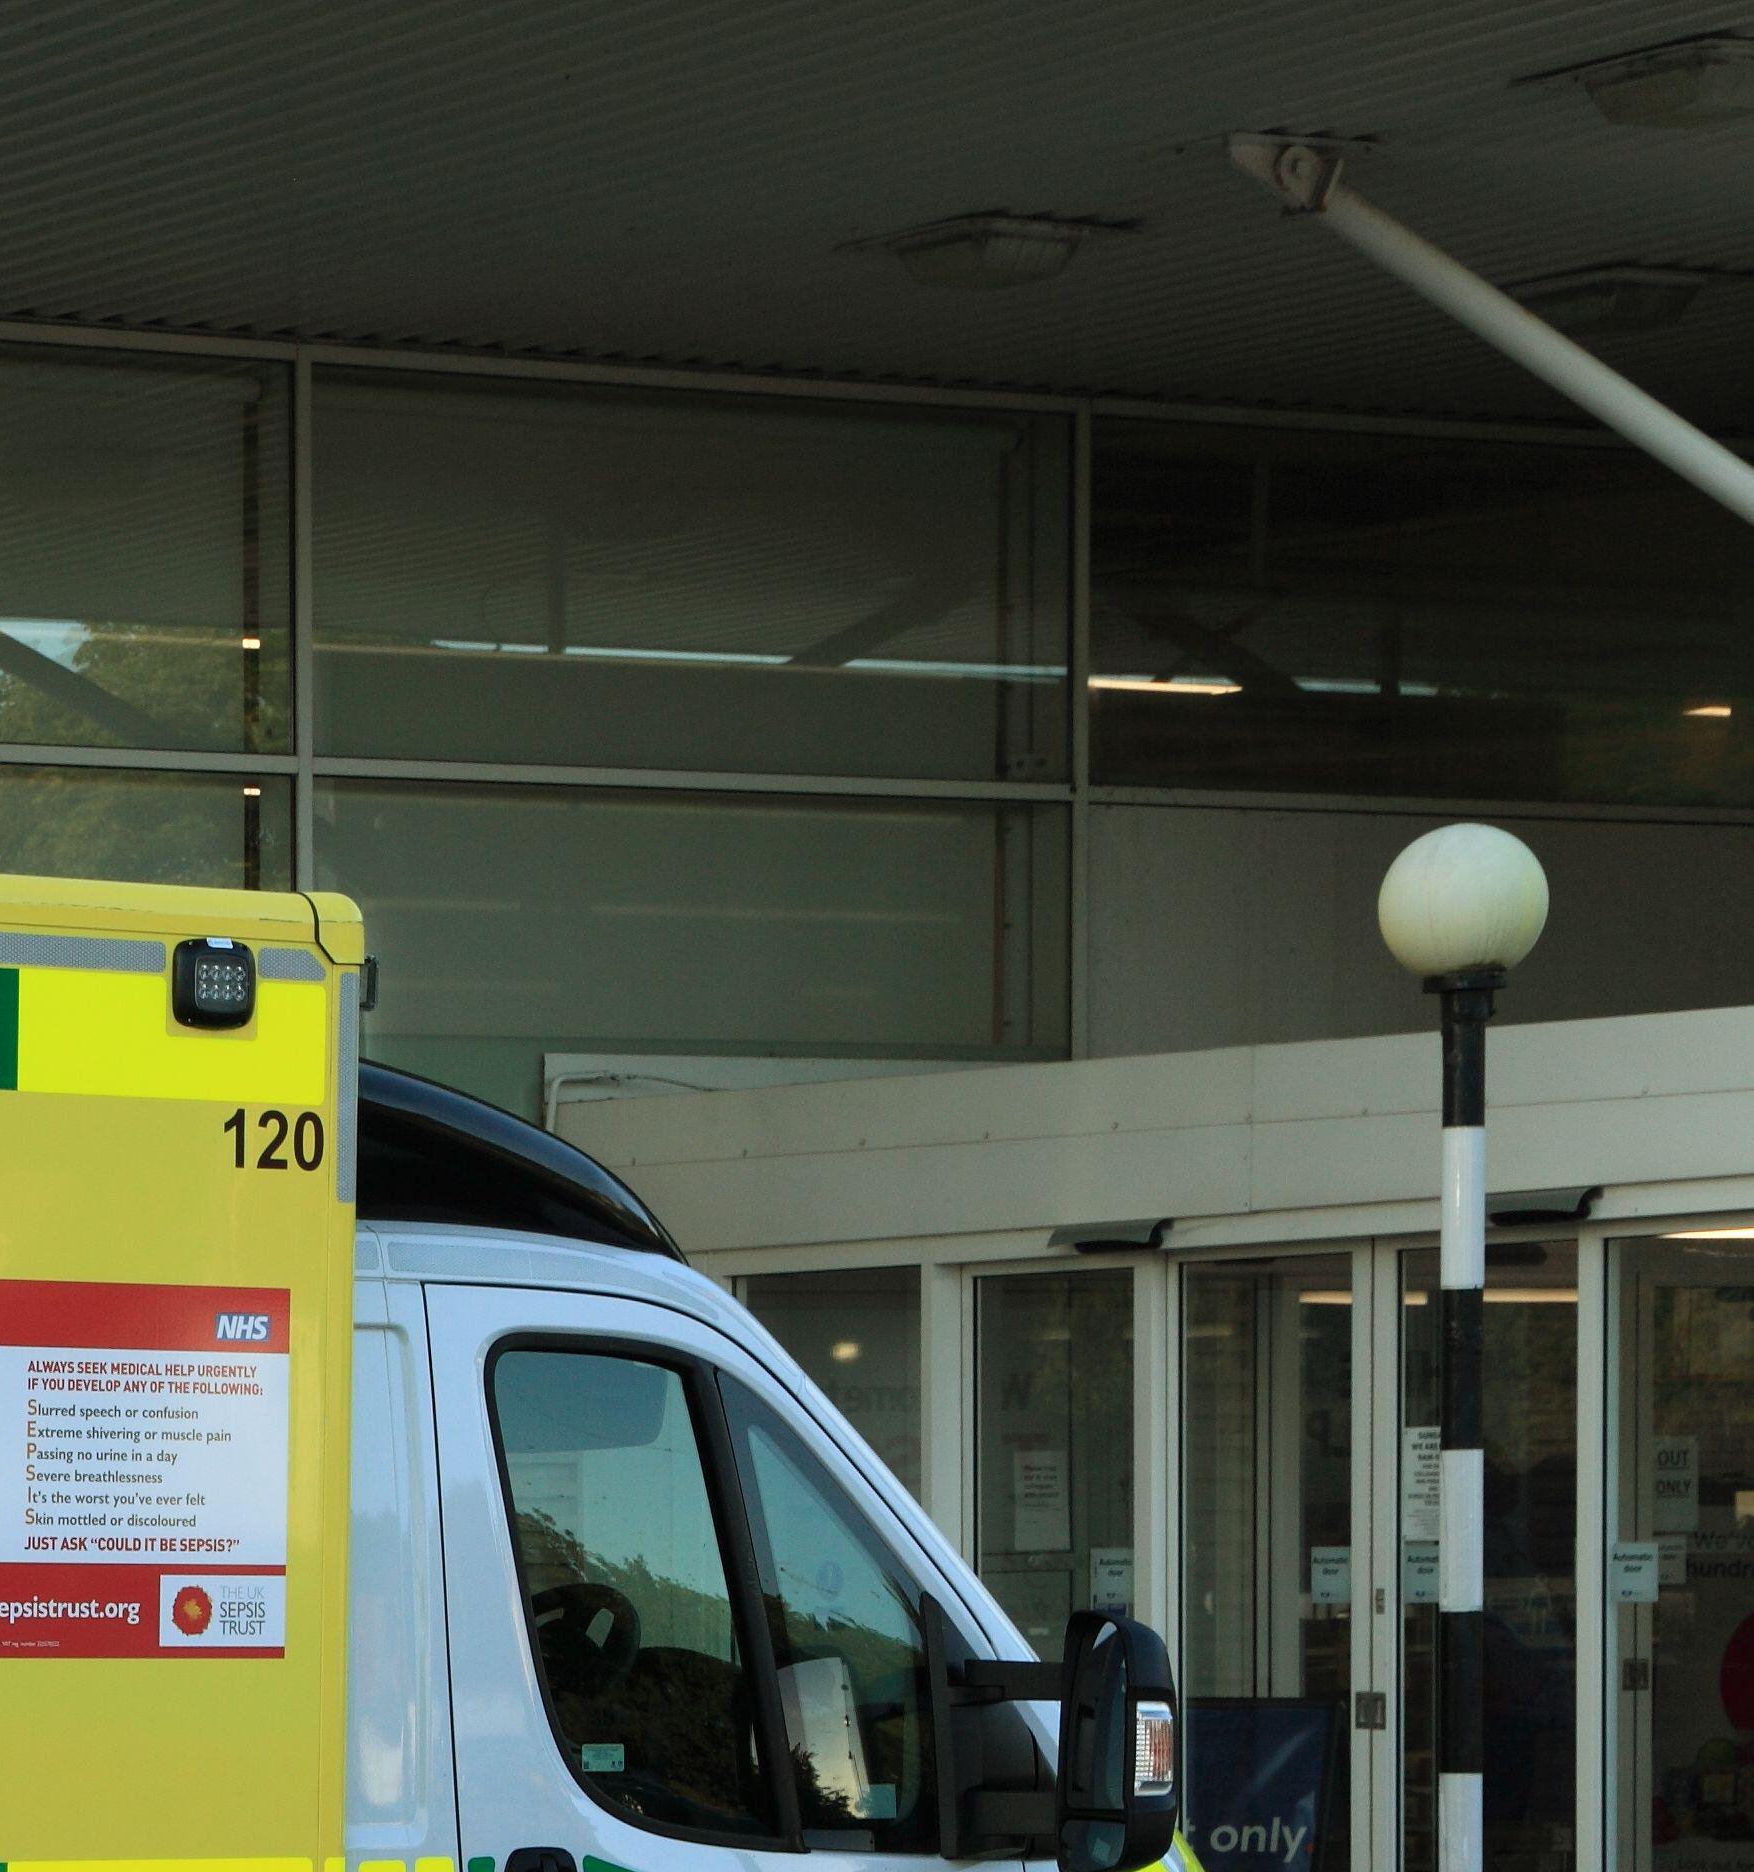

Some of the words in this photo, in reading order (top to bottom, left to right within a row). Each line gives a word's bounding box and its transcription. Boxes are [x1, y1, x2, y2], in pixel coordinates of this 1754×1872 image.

[223, 1108, 324, 1171] 120
[216, 1314, 270, 1341] NHS
[28, 1361, 75, 1373] ALWAYS
[77, 1362, 107, 1374] SEEK
[110, 1363, 162, 1375] MEDICAL
[165, 1364, 194, 1376] HELP
[198, 1365, 257, 1378] URGENTLY
[28, 1378, 38, 1390] IF
[42, 1379, 64, 1391] YOU
[67, 1380, 120, 1392] DEVELOP
[123, 1381, 148, 1393] ANY
[150, 1382, 165, 1393] OF
[168, 1382, 190, 1394] THE
[192, 1383, 263, 1396] FOLLOWING:
[28, 1399, 76, 1417] Slurred
[80, 1404, 121, 1420] speech
[125, 1408, 138, 1417] or
[142, 1405, 199, 1419] confusion
[27, 1421, 82, 1439] Extreme
[86, 1426, 140, 1443] shivering
[144, 1431, 157, 1440] or
[161, 1429, 202, 1441] muscle
[206, 1429, 231, 1444] pain
[26, 1443, 73, 1463] Passing
[77, 1451, 92, 1461] no
[96, 1449, 127, 1461] urine
[131, 1449, 142, 1461] in
[146, 1453, 153, 1461] a
[156, 1450, 177, 1465] day
[1658, 1450, 1689, 1466] OUT
[26, 1465, 70, 1482] Severe
[74, 1470, 163, 1483] breathlessness
[1657, 1480, 1692, 1494] ONLY
[28, 1487, 47, 1503] It's
[51, 1491, 71, 1504] the
[75, 1492, 109, 1505] worst
[113, 1493, 152, 1507] you've
[156, 1495, 182, 1505] ever
[186, 1493, 205, 1505] felt
[25, 1508, 53, 1525] Skin
[58, 1513, 106, 1526] mottled
[110, 1516, 124, 1526] or
[127, 1514, 196, 1527] discoloured
[24, 1537, 57, 1550] JUST
[61, 1537, 87, 1551] ASK
[91, 1537, 141, 1551] “COULD
[144, 1538, 156, 1551] IT
[160, 1538, 176, 1551] BE
[179, 1538, 239, 1552] SEPSIS?”
[1323, 1567, 1339, 1575] door
[1417, 1566, 1434, 1574] door
[1624, 1565, 1642, 1573] door
[219, 1585, 243, 1598] THE
[245, 1586, 264, 1599] UK
[219, 1602, 266, 1619] SEPSIS
[219, 1619, 266, 1636] TRUST
